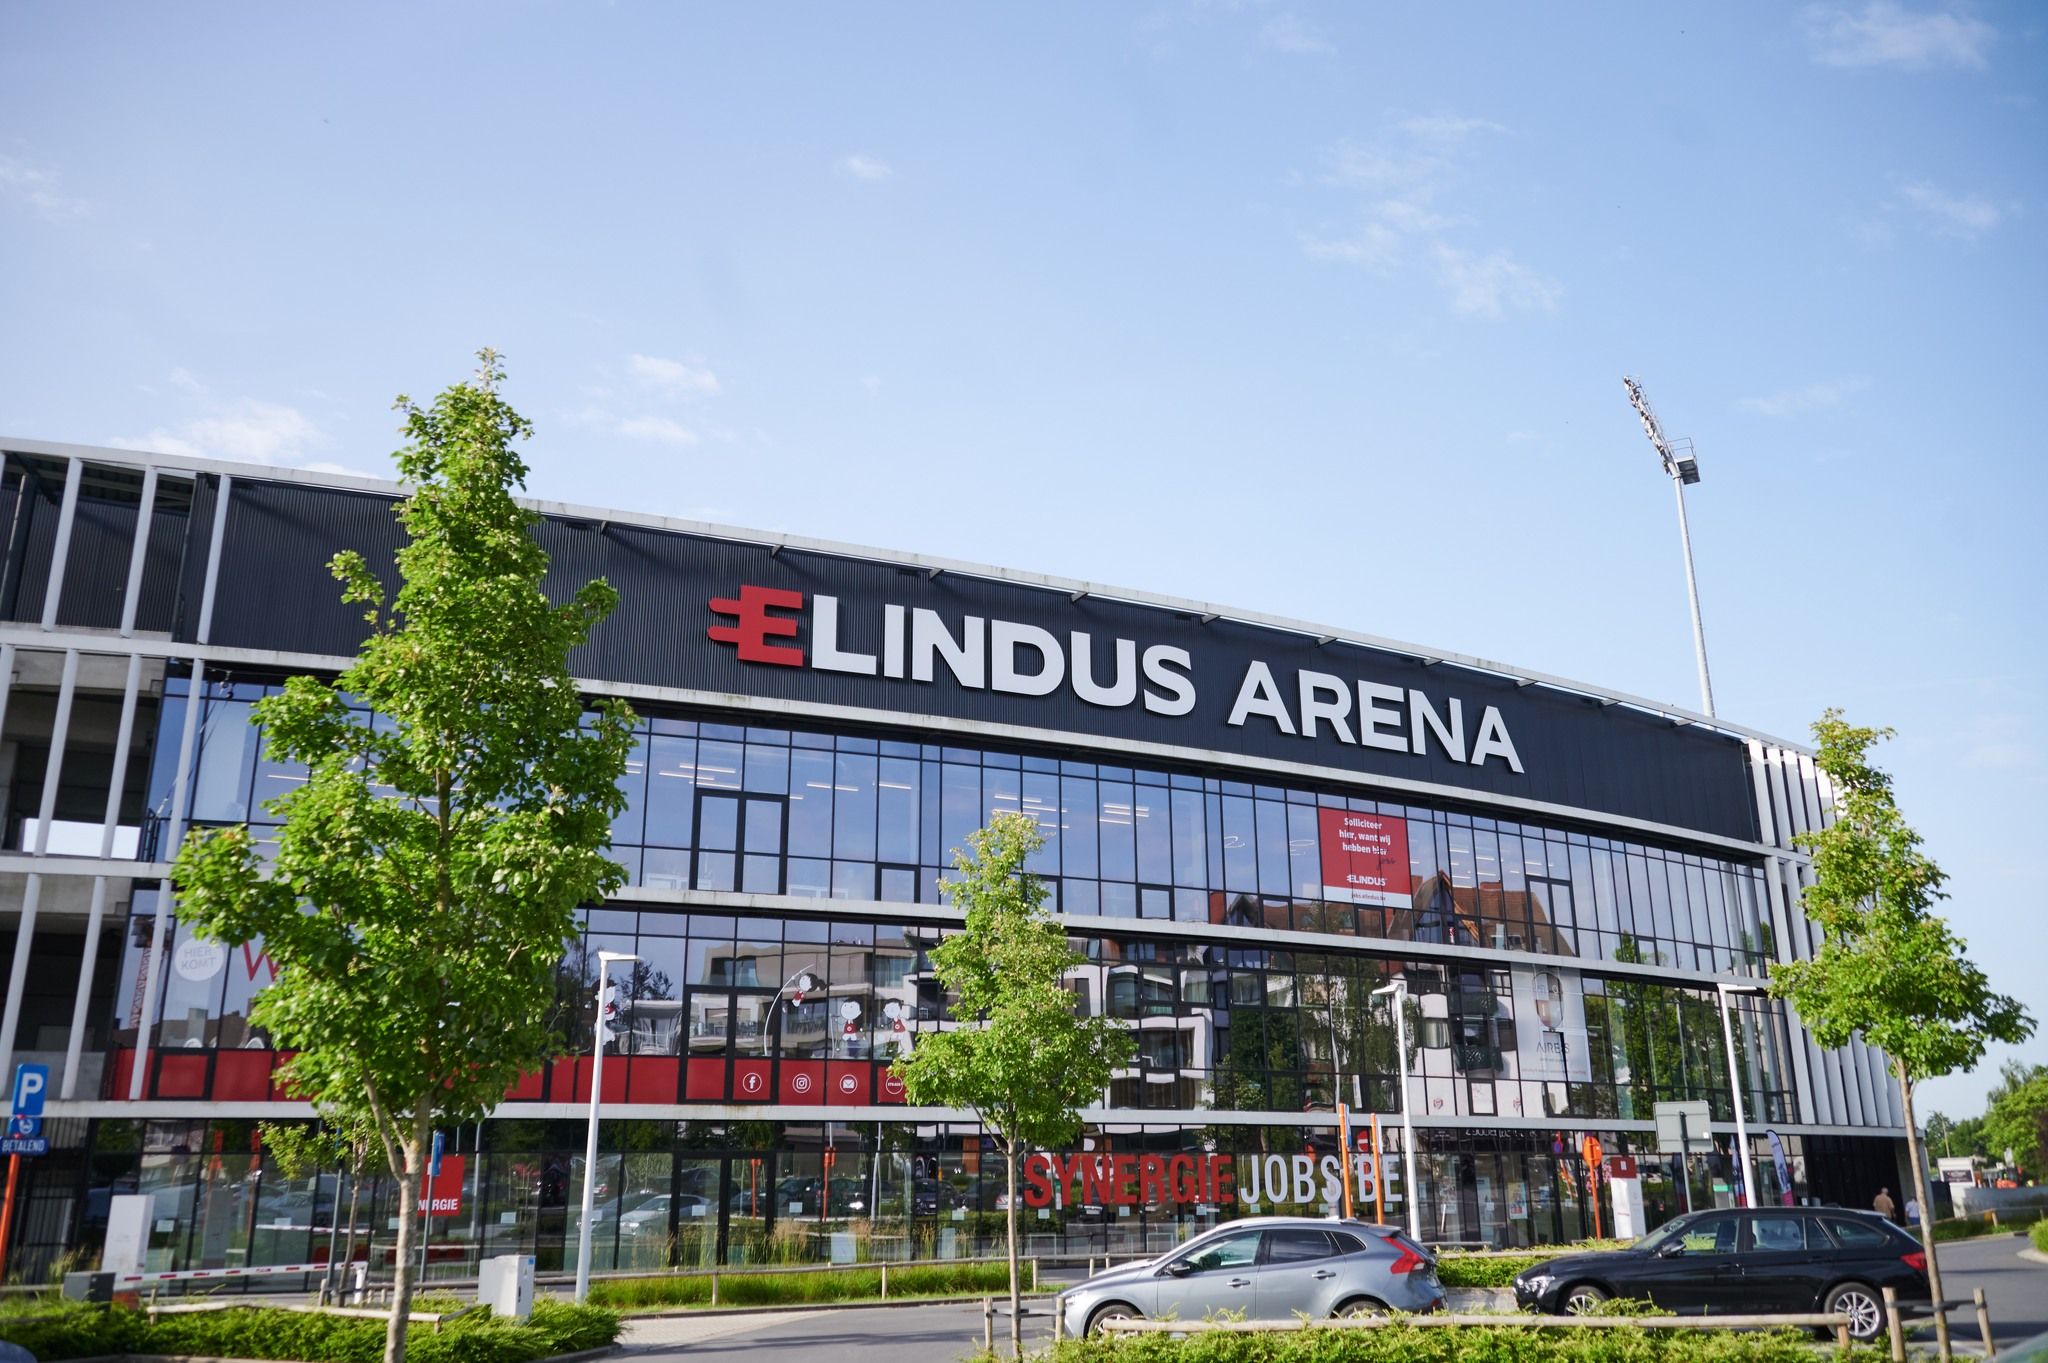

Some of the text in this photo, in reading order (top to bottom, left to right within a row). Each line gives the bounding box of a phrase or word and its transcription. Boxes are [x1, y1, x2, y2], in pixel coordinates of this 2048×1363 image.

[707, 584, 1525, 774] ELINDUS ARENA
[1344, 818, 1382, 829] Solliciteer
[1339, 829, 1391, 845] hier, want wij
[1342, 842, 1371, 853] hebben
[1346, 874, 1386, 886] ELINDUS
[181, 957, 217, 971] KOMT
[18, 1072, 44, 1108] P
[1, 1139, 45, 1153] BETALEND
[1023, 1153, 1234, 1207] SYNERGIE
